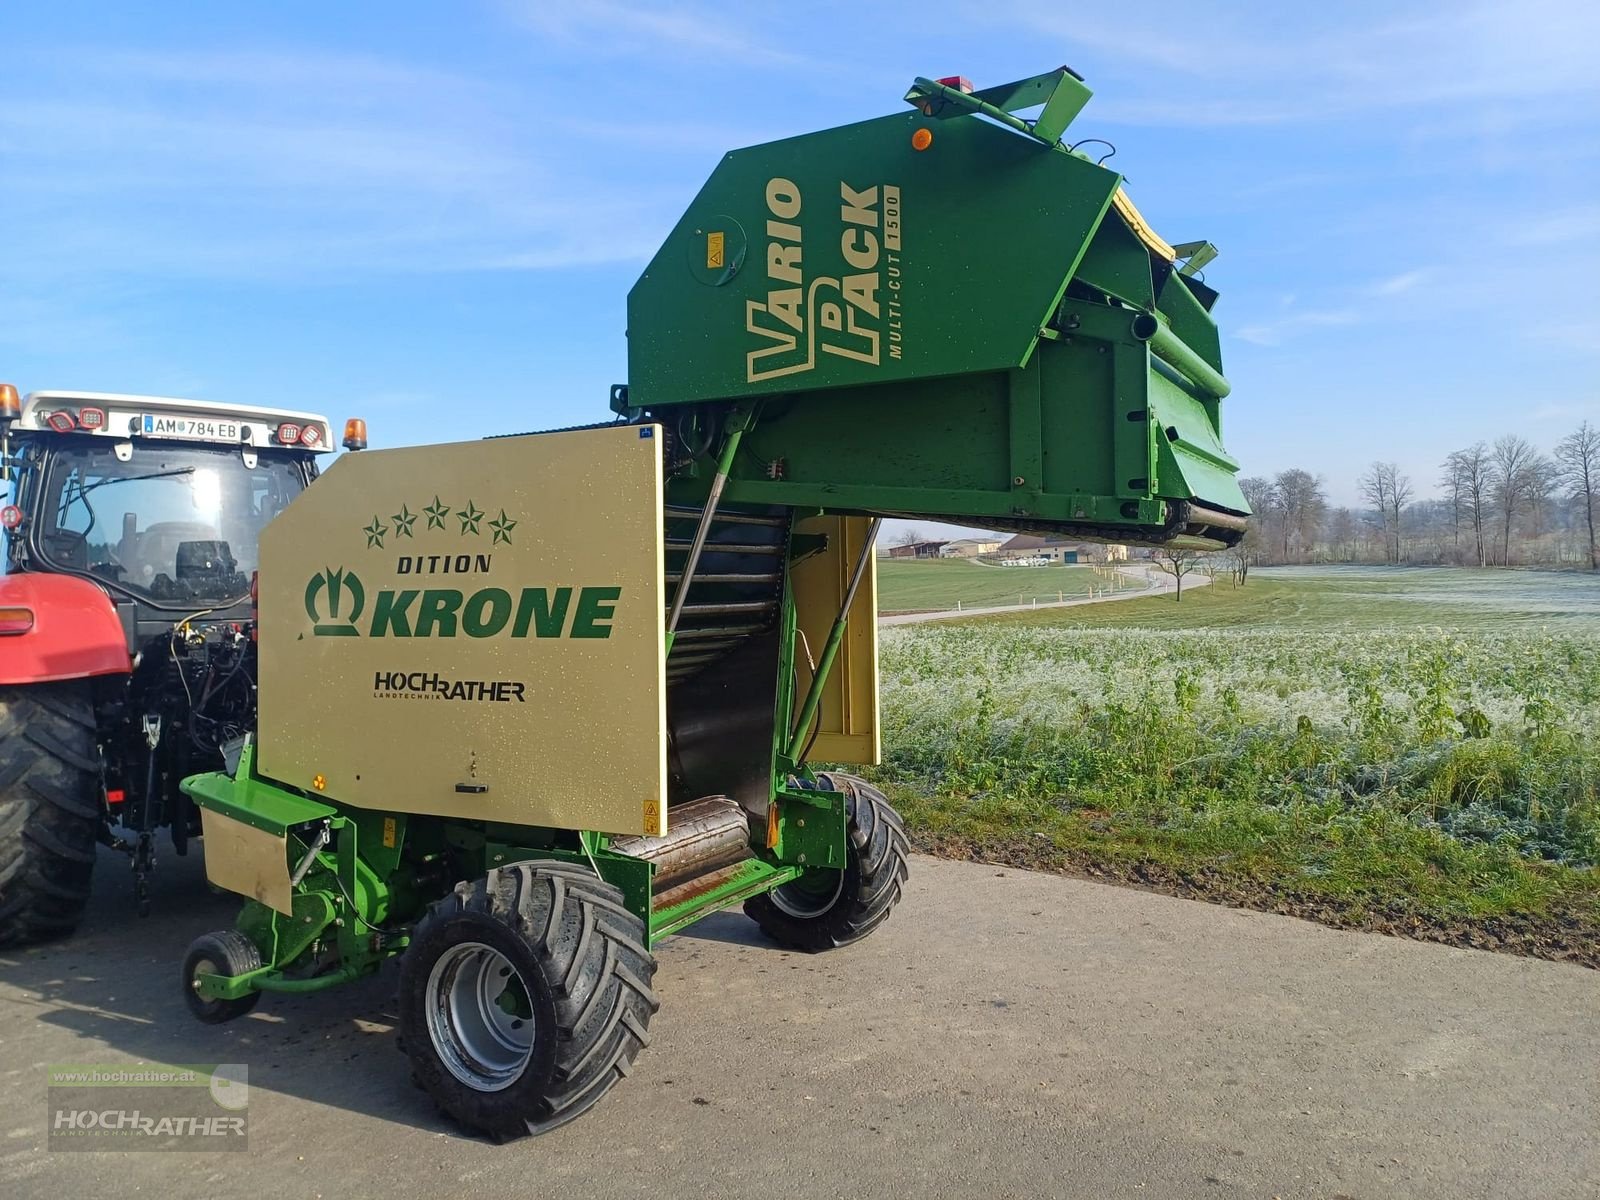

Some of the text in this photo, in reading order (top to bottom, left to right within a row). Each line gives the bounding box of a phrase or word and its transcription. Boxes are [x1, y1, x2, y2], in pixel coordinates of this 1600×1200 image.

[746, 177, 806, 383] VARIO
[811, 181, 880, 366] PACK
[886, 195, 902, 360] MULTI-CUT 1500
[155, 419, 176, 433] AM
[187, 421, 215, 436] 784
[218, 424, 236, 437] EB
[369, 586, 622, 639] KRONE
[373, 692, 441, 700] LANDTECHNIK
[374, 671, 525, 702] HOCHRATHER
